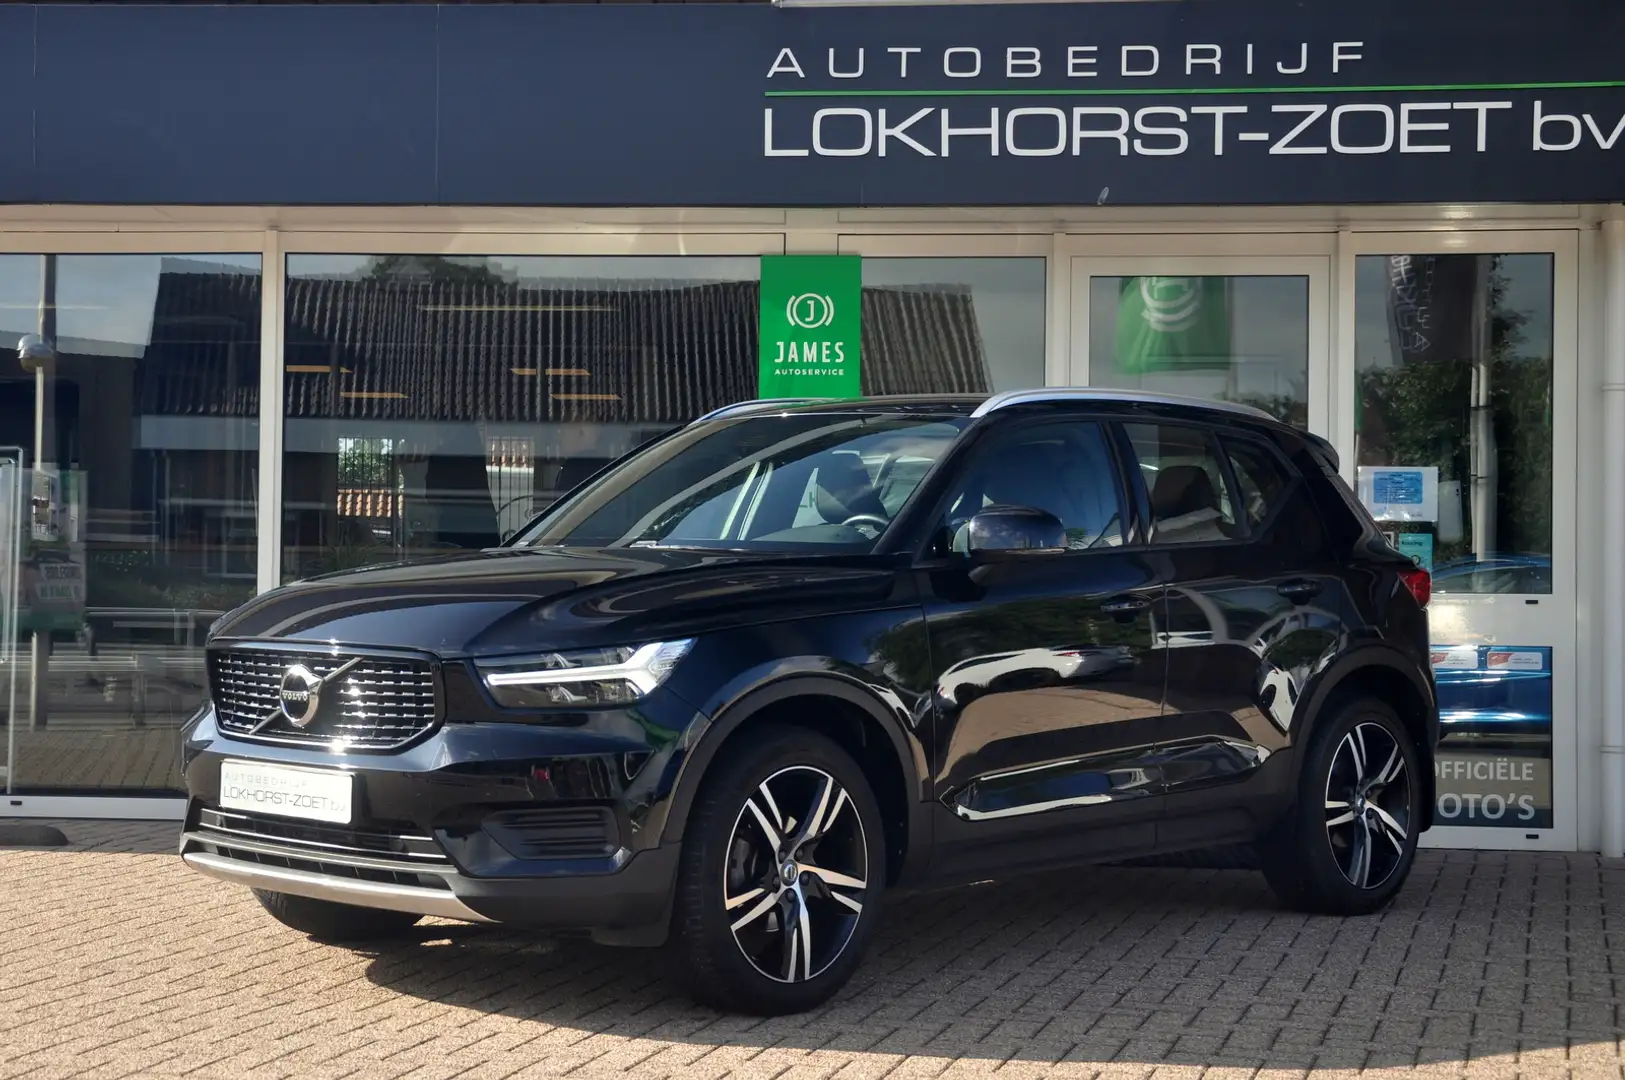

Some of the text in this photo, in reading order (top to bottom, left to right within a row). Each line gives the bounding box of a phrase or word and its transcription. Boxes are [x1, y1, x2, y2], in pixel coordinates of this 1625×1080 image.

[766, 41, 1364, 79] AUTOBEDRIJF
[763, 100, 1625, 157] LOKHORST-ZOET bv
[774, 341, 845, 363] JAMES
[774, 368, 845, 376] AUTOSERVICE
[281, 690, 309, 702] VOLVO
[223, 786, 329, 809] LOKHORST-ZOET
[1437, 793, 1536, 821] OTO'S
